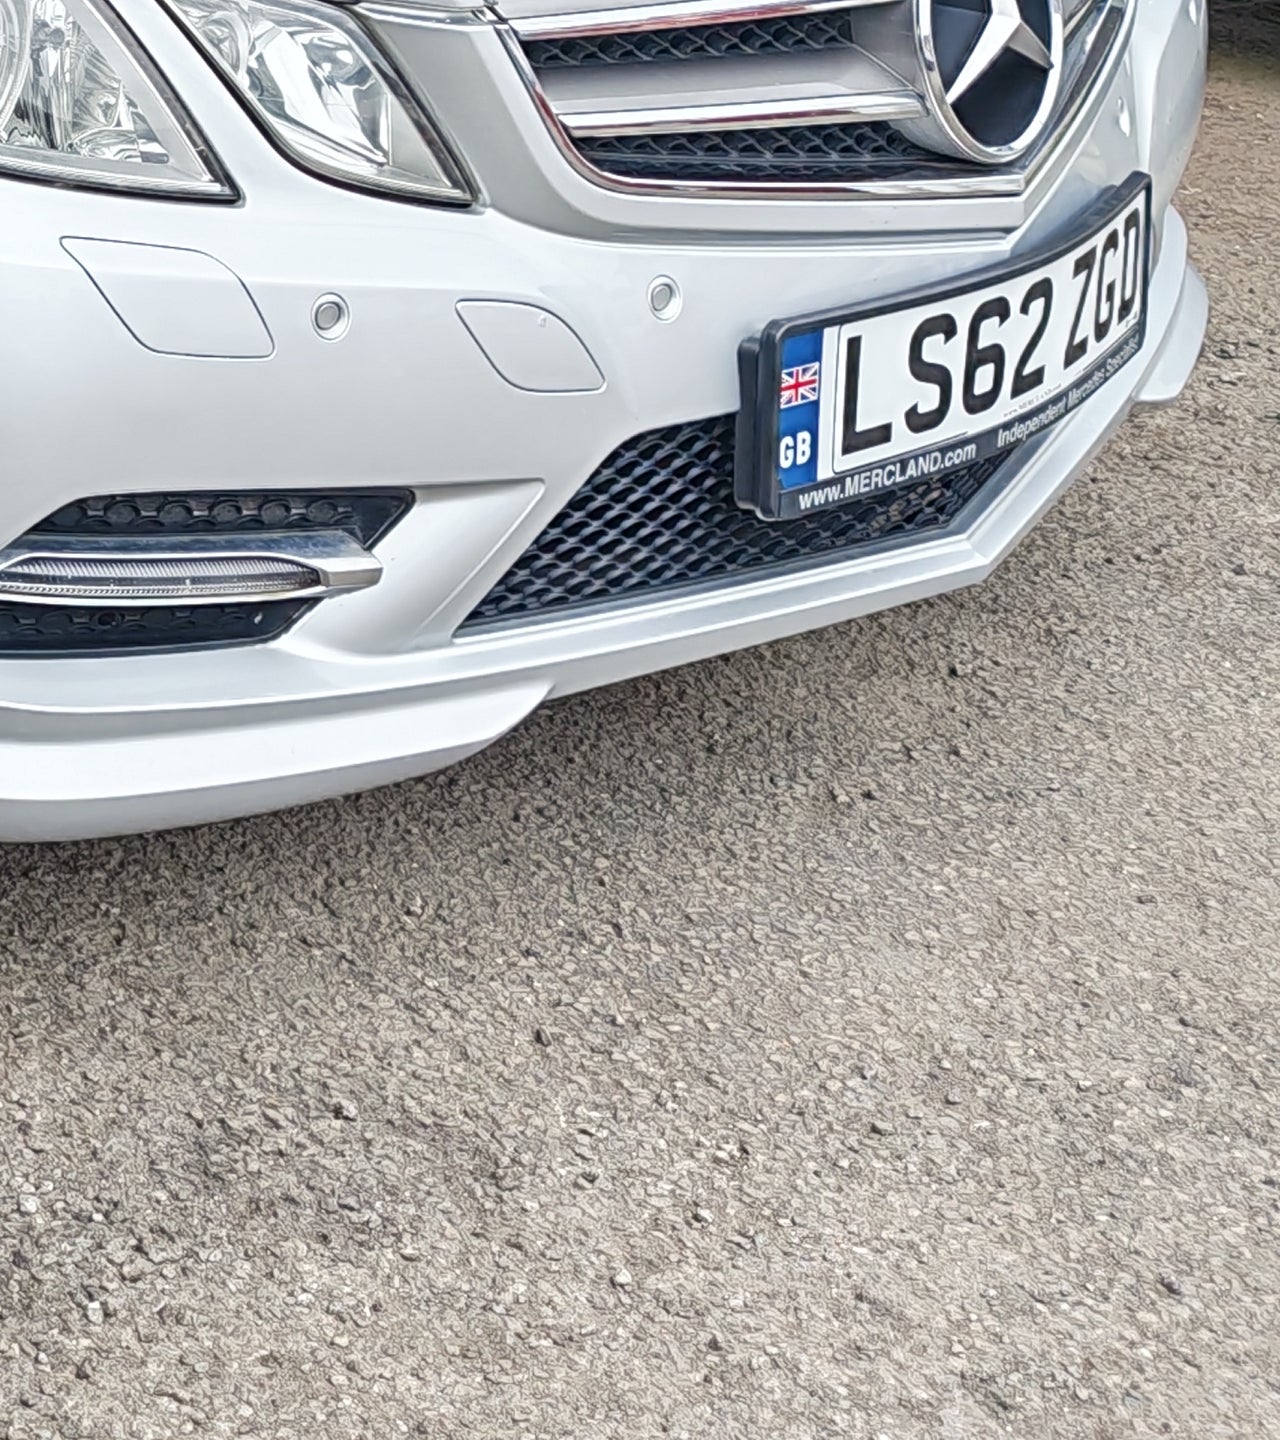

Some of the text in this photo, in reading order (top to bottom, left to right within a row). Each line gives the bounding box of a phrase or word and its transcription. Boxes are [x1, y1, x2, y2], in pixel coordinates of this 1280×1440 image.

[840, 207, 1140, 457] LS62 ZGD
[779, 430, 812, 469] GB
[798, 442, 977, 509] www.MERCLAND.com
